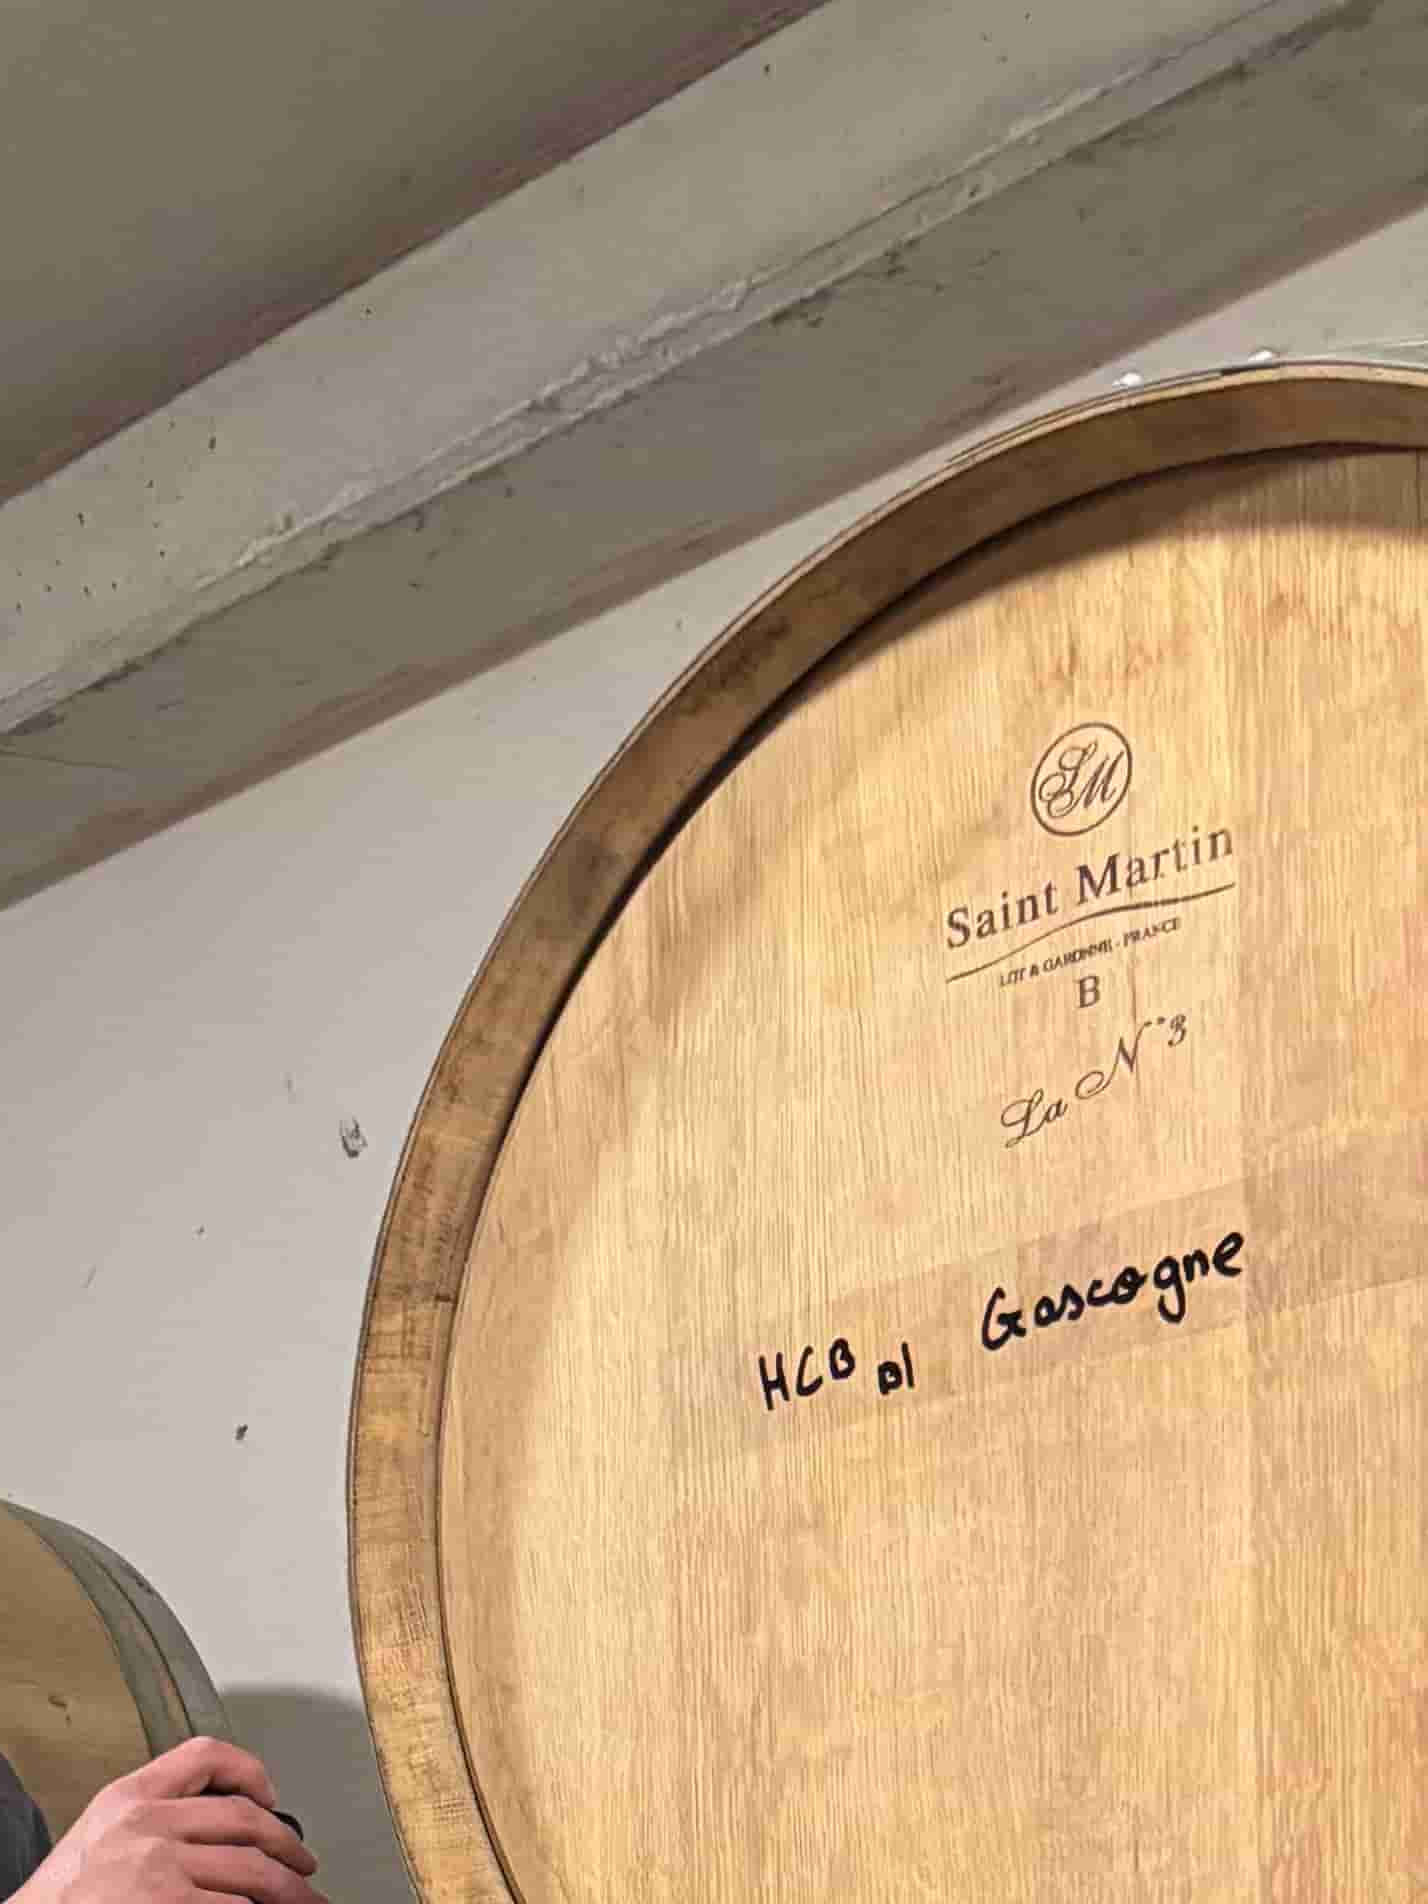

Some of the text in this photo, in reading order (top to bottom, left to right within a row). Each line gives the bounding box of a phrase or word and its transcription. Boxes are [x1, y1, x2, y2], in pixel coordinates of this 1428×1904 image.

[946, 826, 1234, 949] Saint Martin
[1079, 975, 1101, 1008] B
[980, 1230, 1245, 1351] Gascogne
